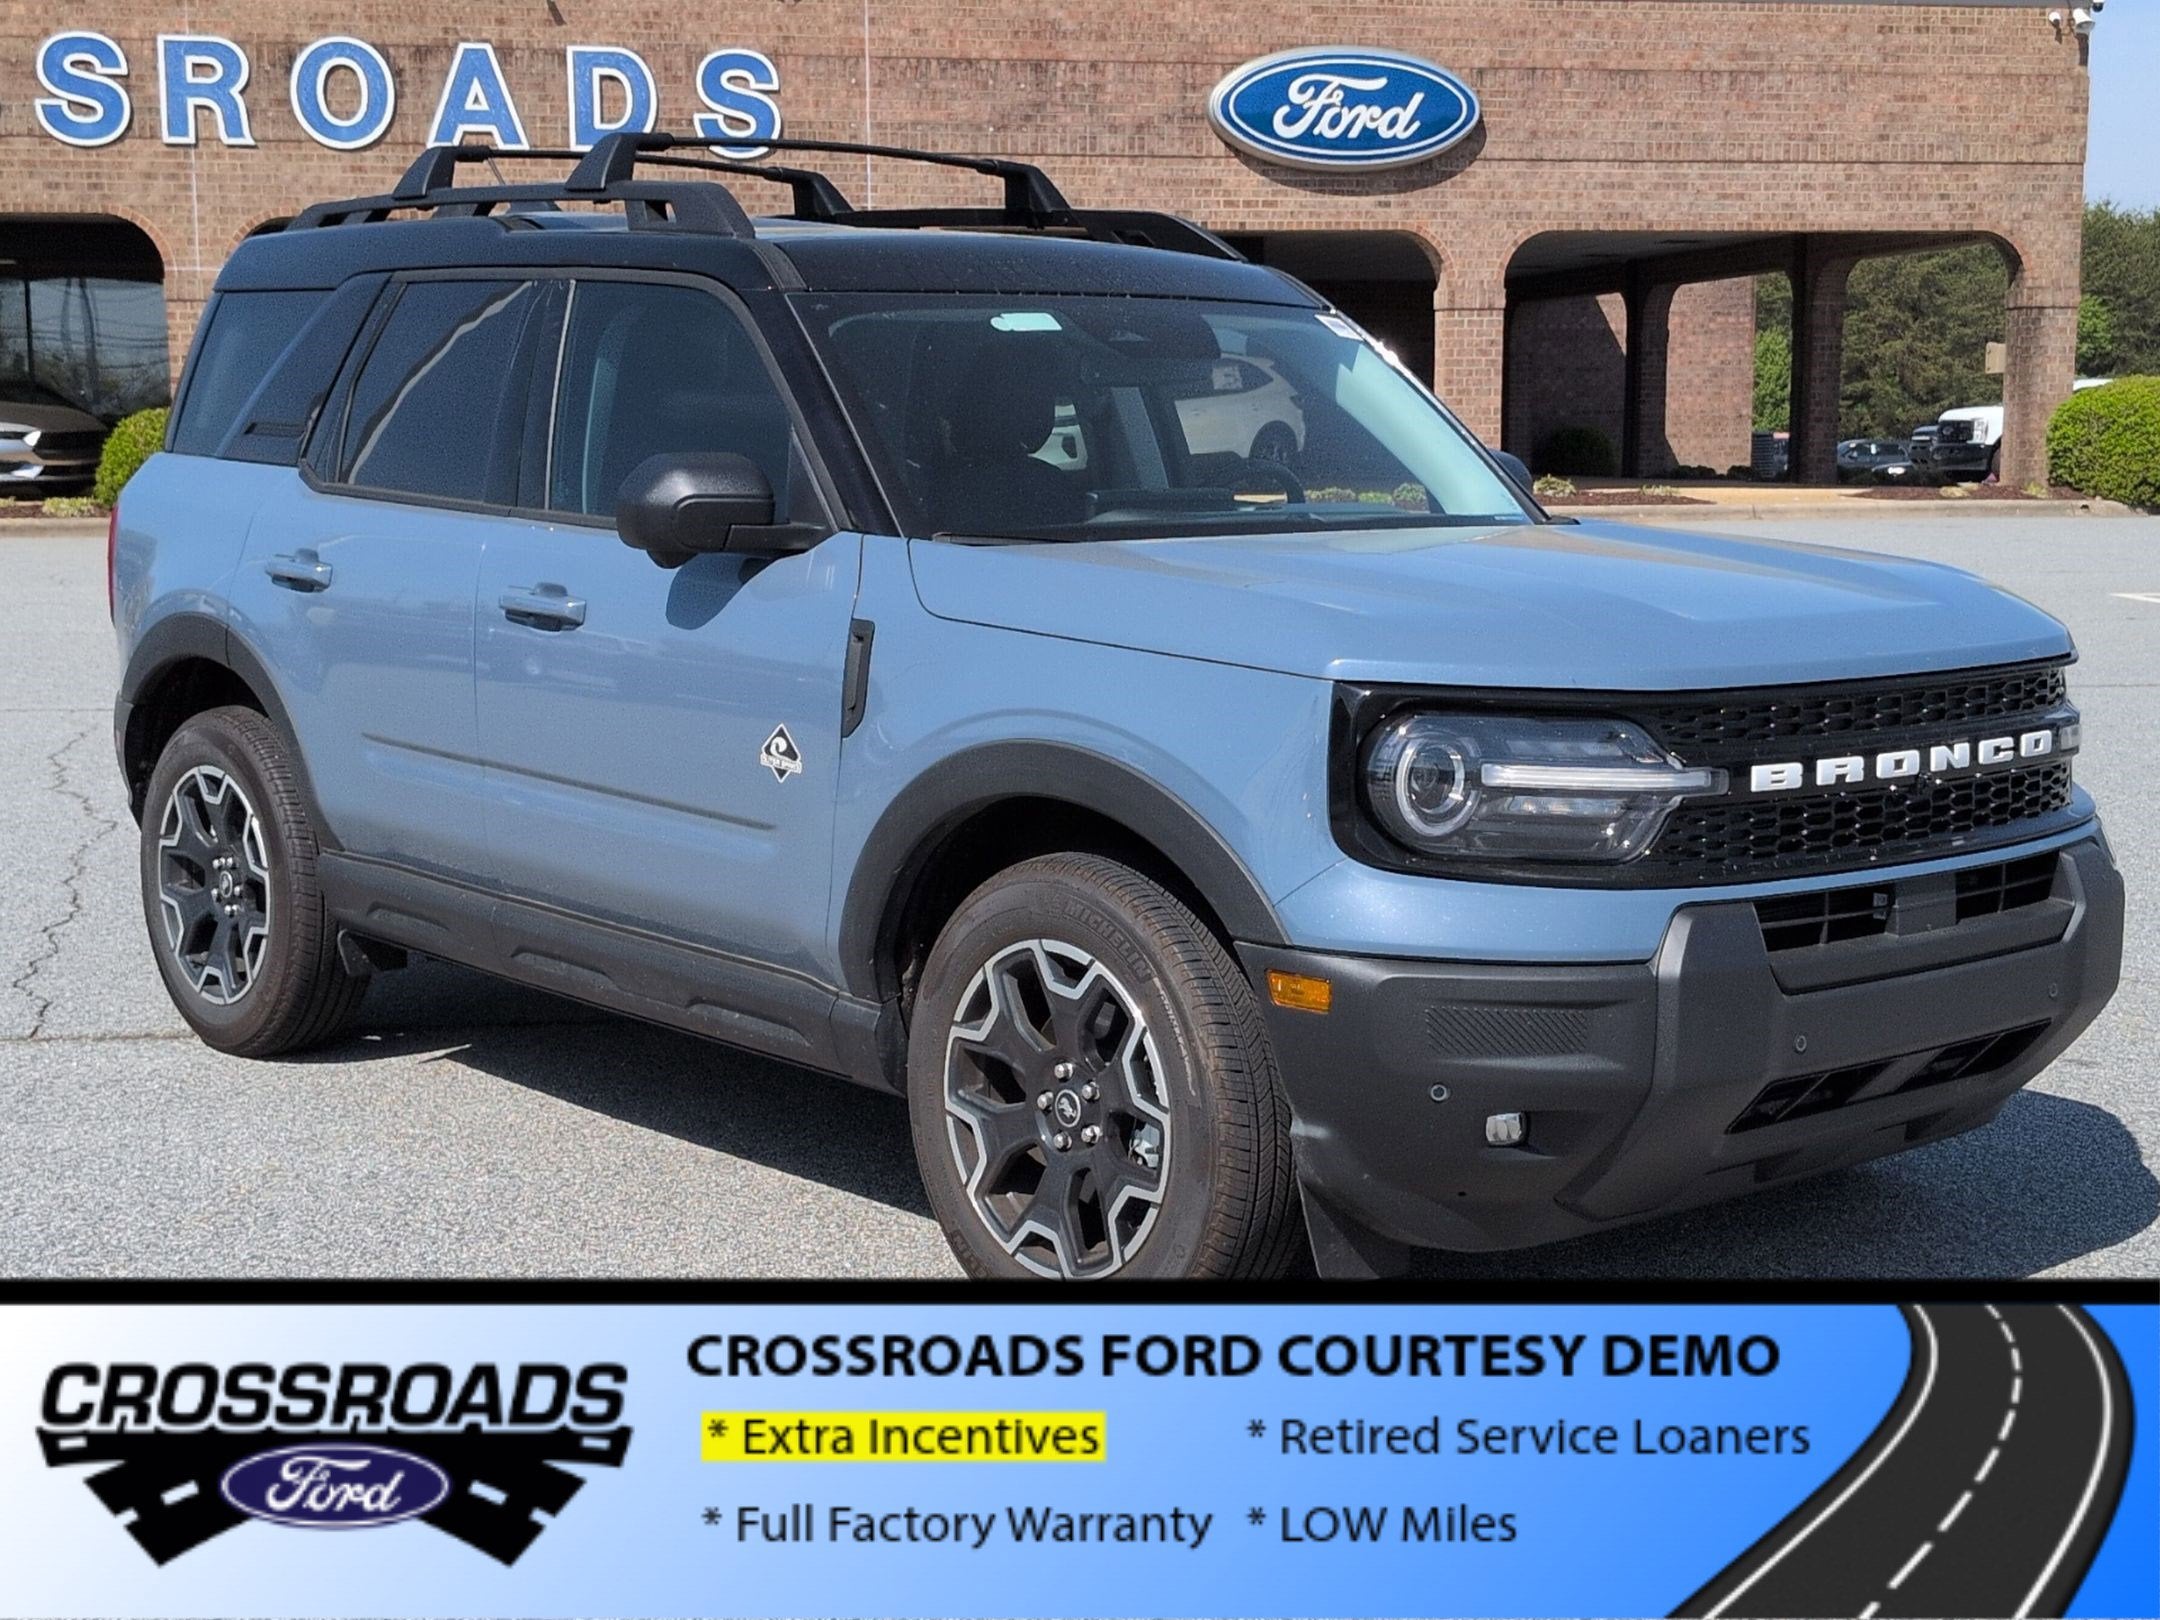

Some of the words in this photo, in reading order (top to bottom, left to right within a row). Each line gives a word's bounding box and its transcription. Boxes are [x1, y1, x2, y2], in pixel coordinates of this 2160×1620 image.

[34, 31, 783, 159] SROADS
[1272, 73, 1425, 139] Ford
[1750, 729, 2053, 793] BRONCO
